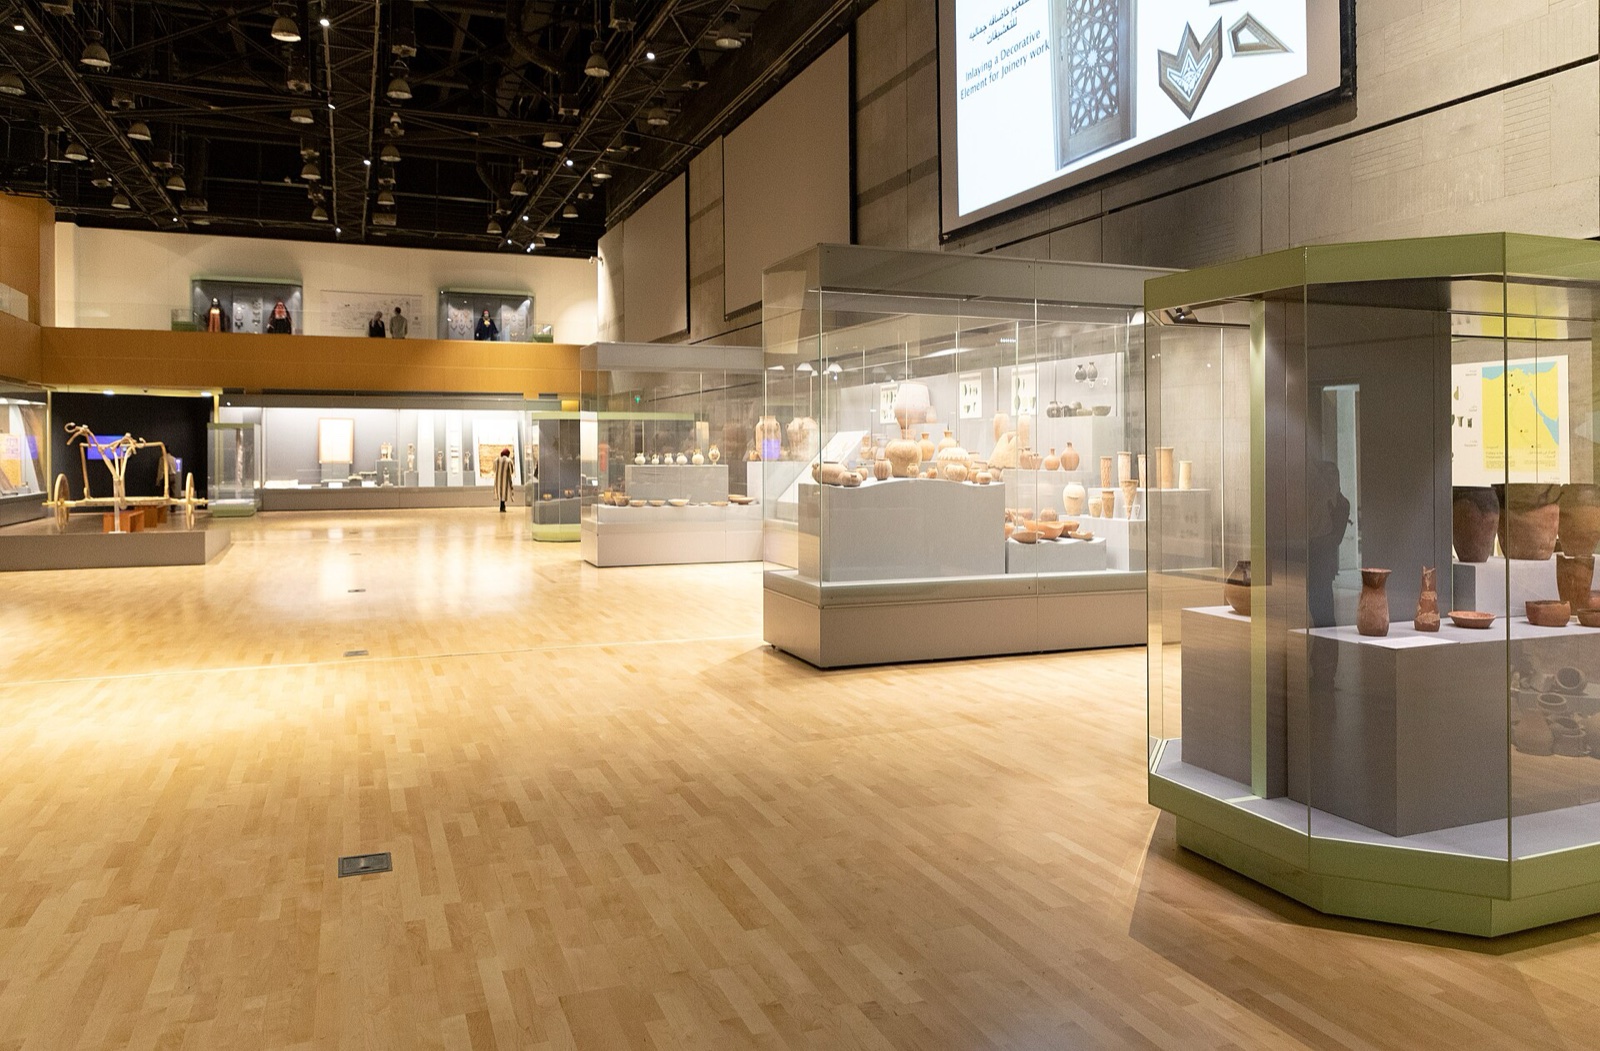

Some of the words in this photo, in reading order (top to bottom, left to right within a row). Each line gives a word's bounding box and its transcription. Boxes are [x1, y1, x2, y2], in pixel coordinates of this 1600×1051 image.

[960, 77, 987, 100] Element
[989, 71, 999, 83] for
[1001, 55, 1027, 79] Joinery
[1029, 39, 1050, 60] work
[965, 59, 992, 81] Inlaying
[994, 56, 998, 65] a
[1000, 29, 1040, 61] Decorative
